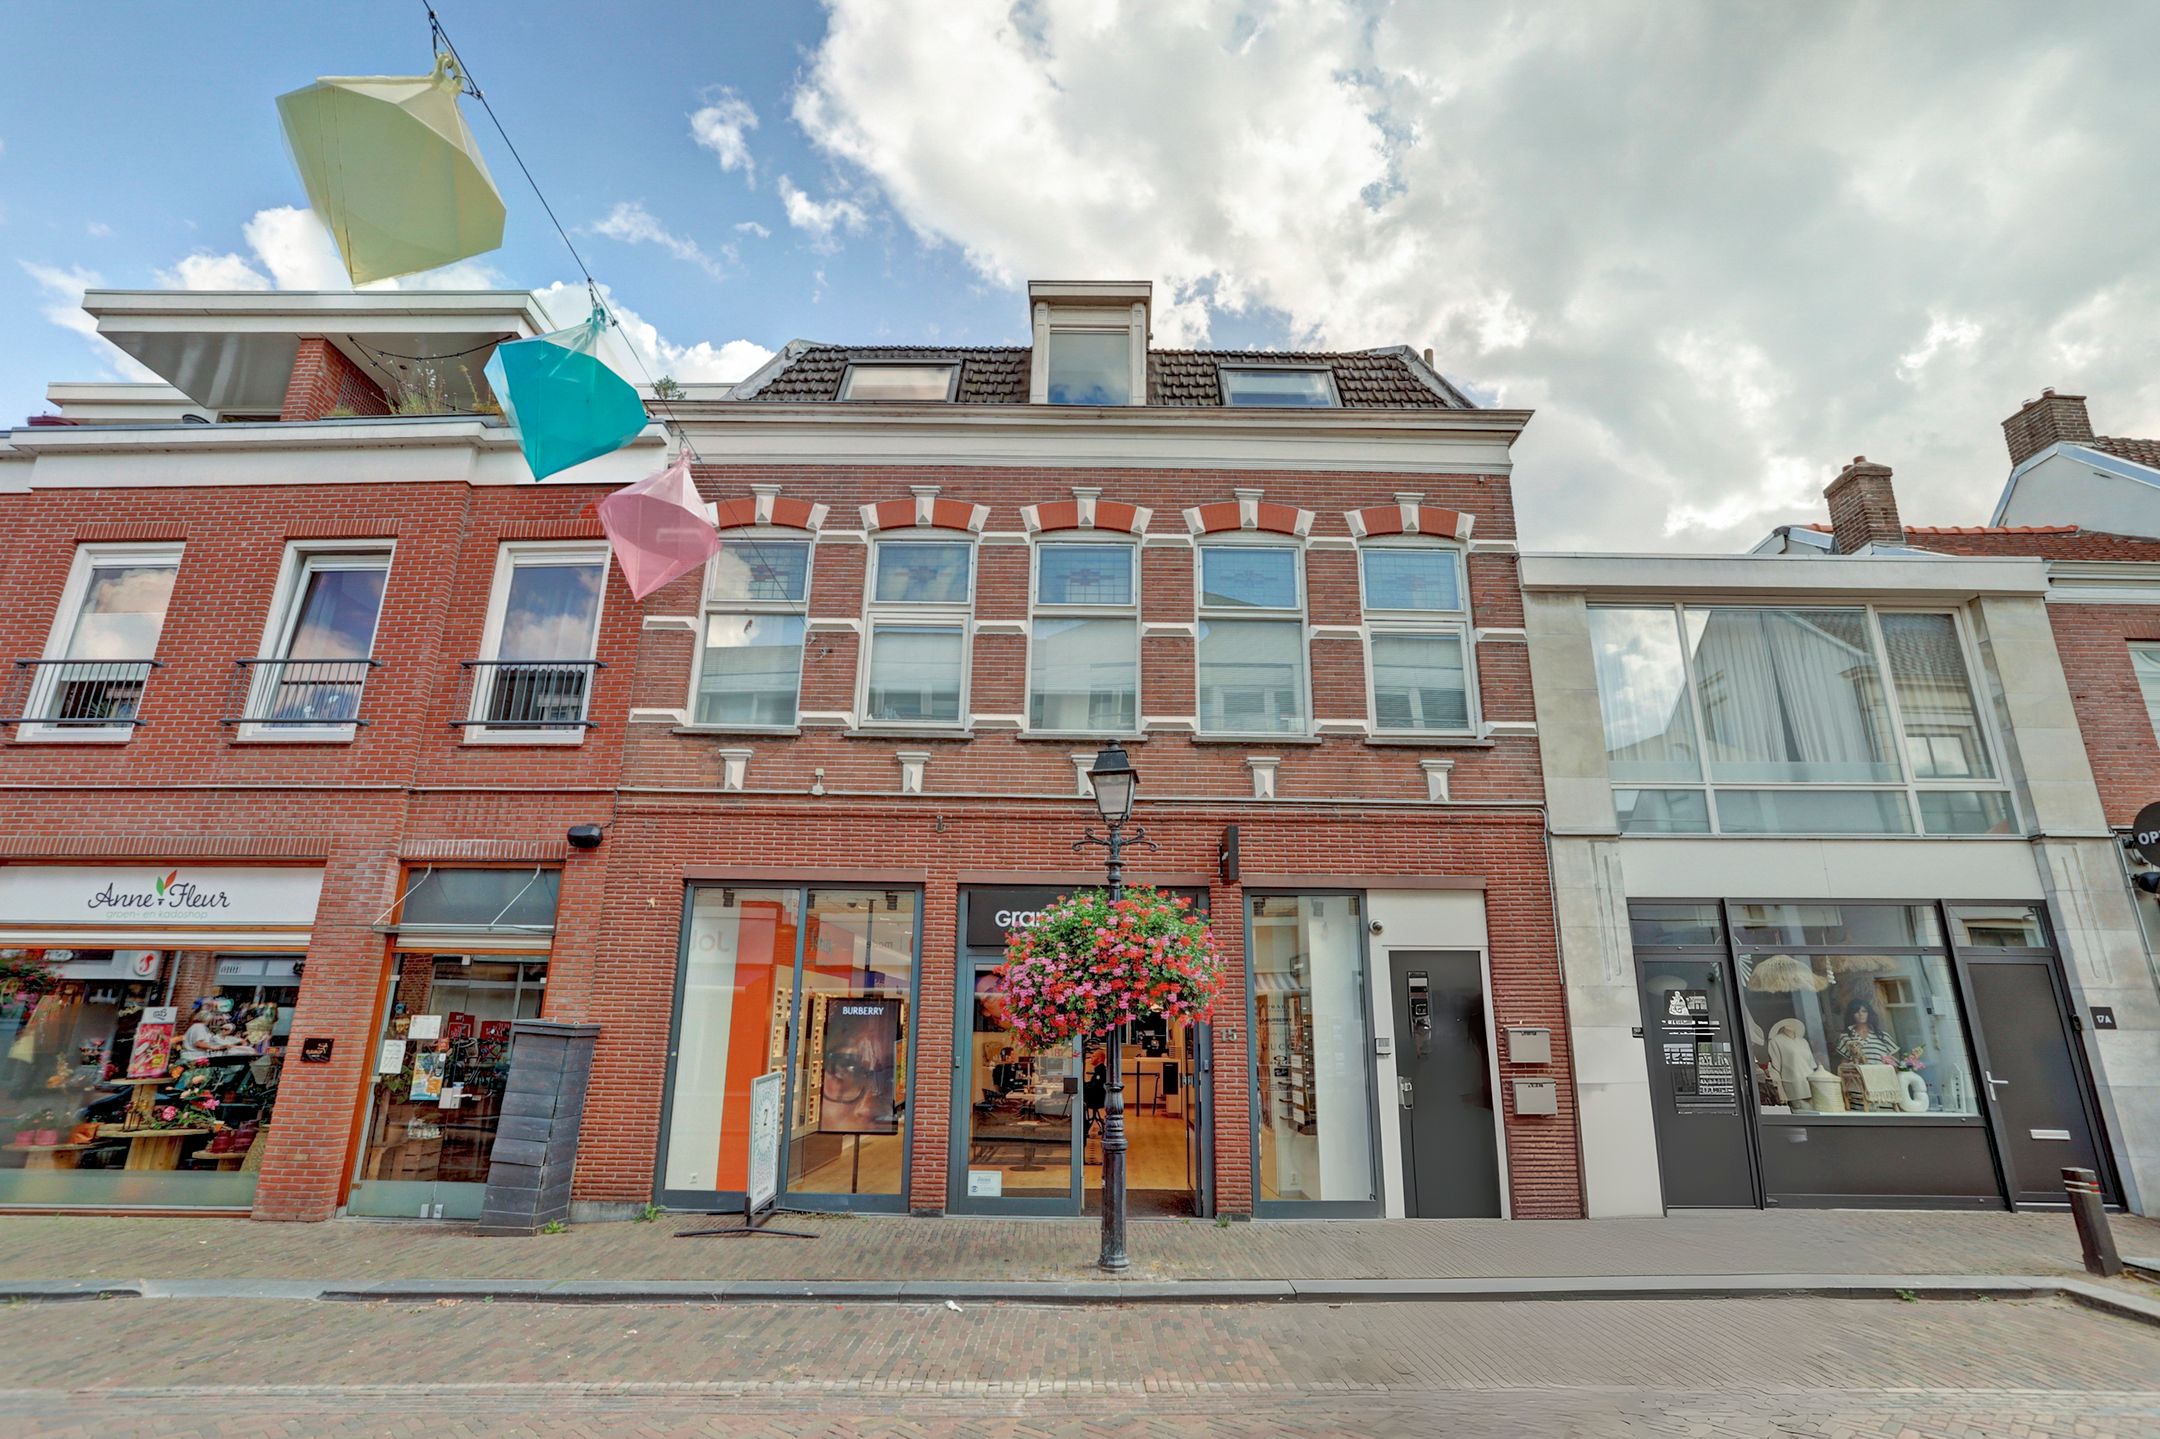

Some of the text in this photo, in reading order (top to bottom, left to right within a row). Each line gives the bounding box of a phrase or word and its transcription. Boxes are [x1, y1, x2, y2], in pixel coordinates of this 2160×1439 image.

[2138, 831, 2160, 845] OP
[88, 882, 230, 908] Anne Fleur
[842, 1006, 884, 1016] BURBERRY
[2096, 1015, 2112, 1024] 17A
[1221, 1027, 1237, 1041] 15
